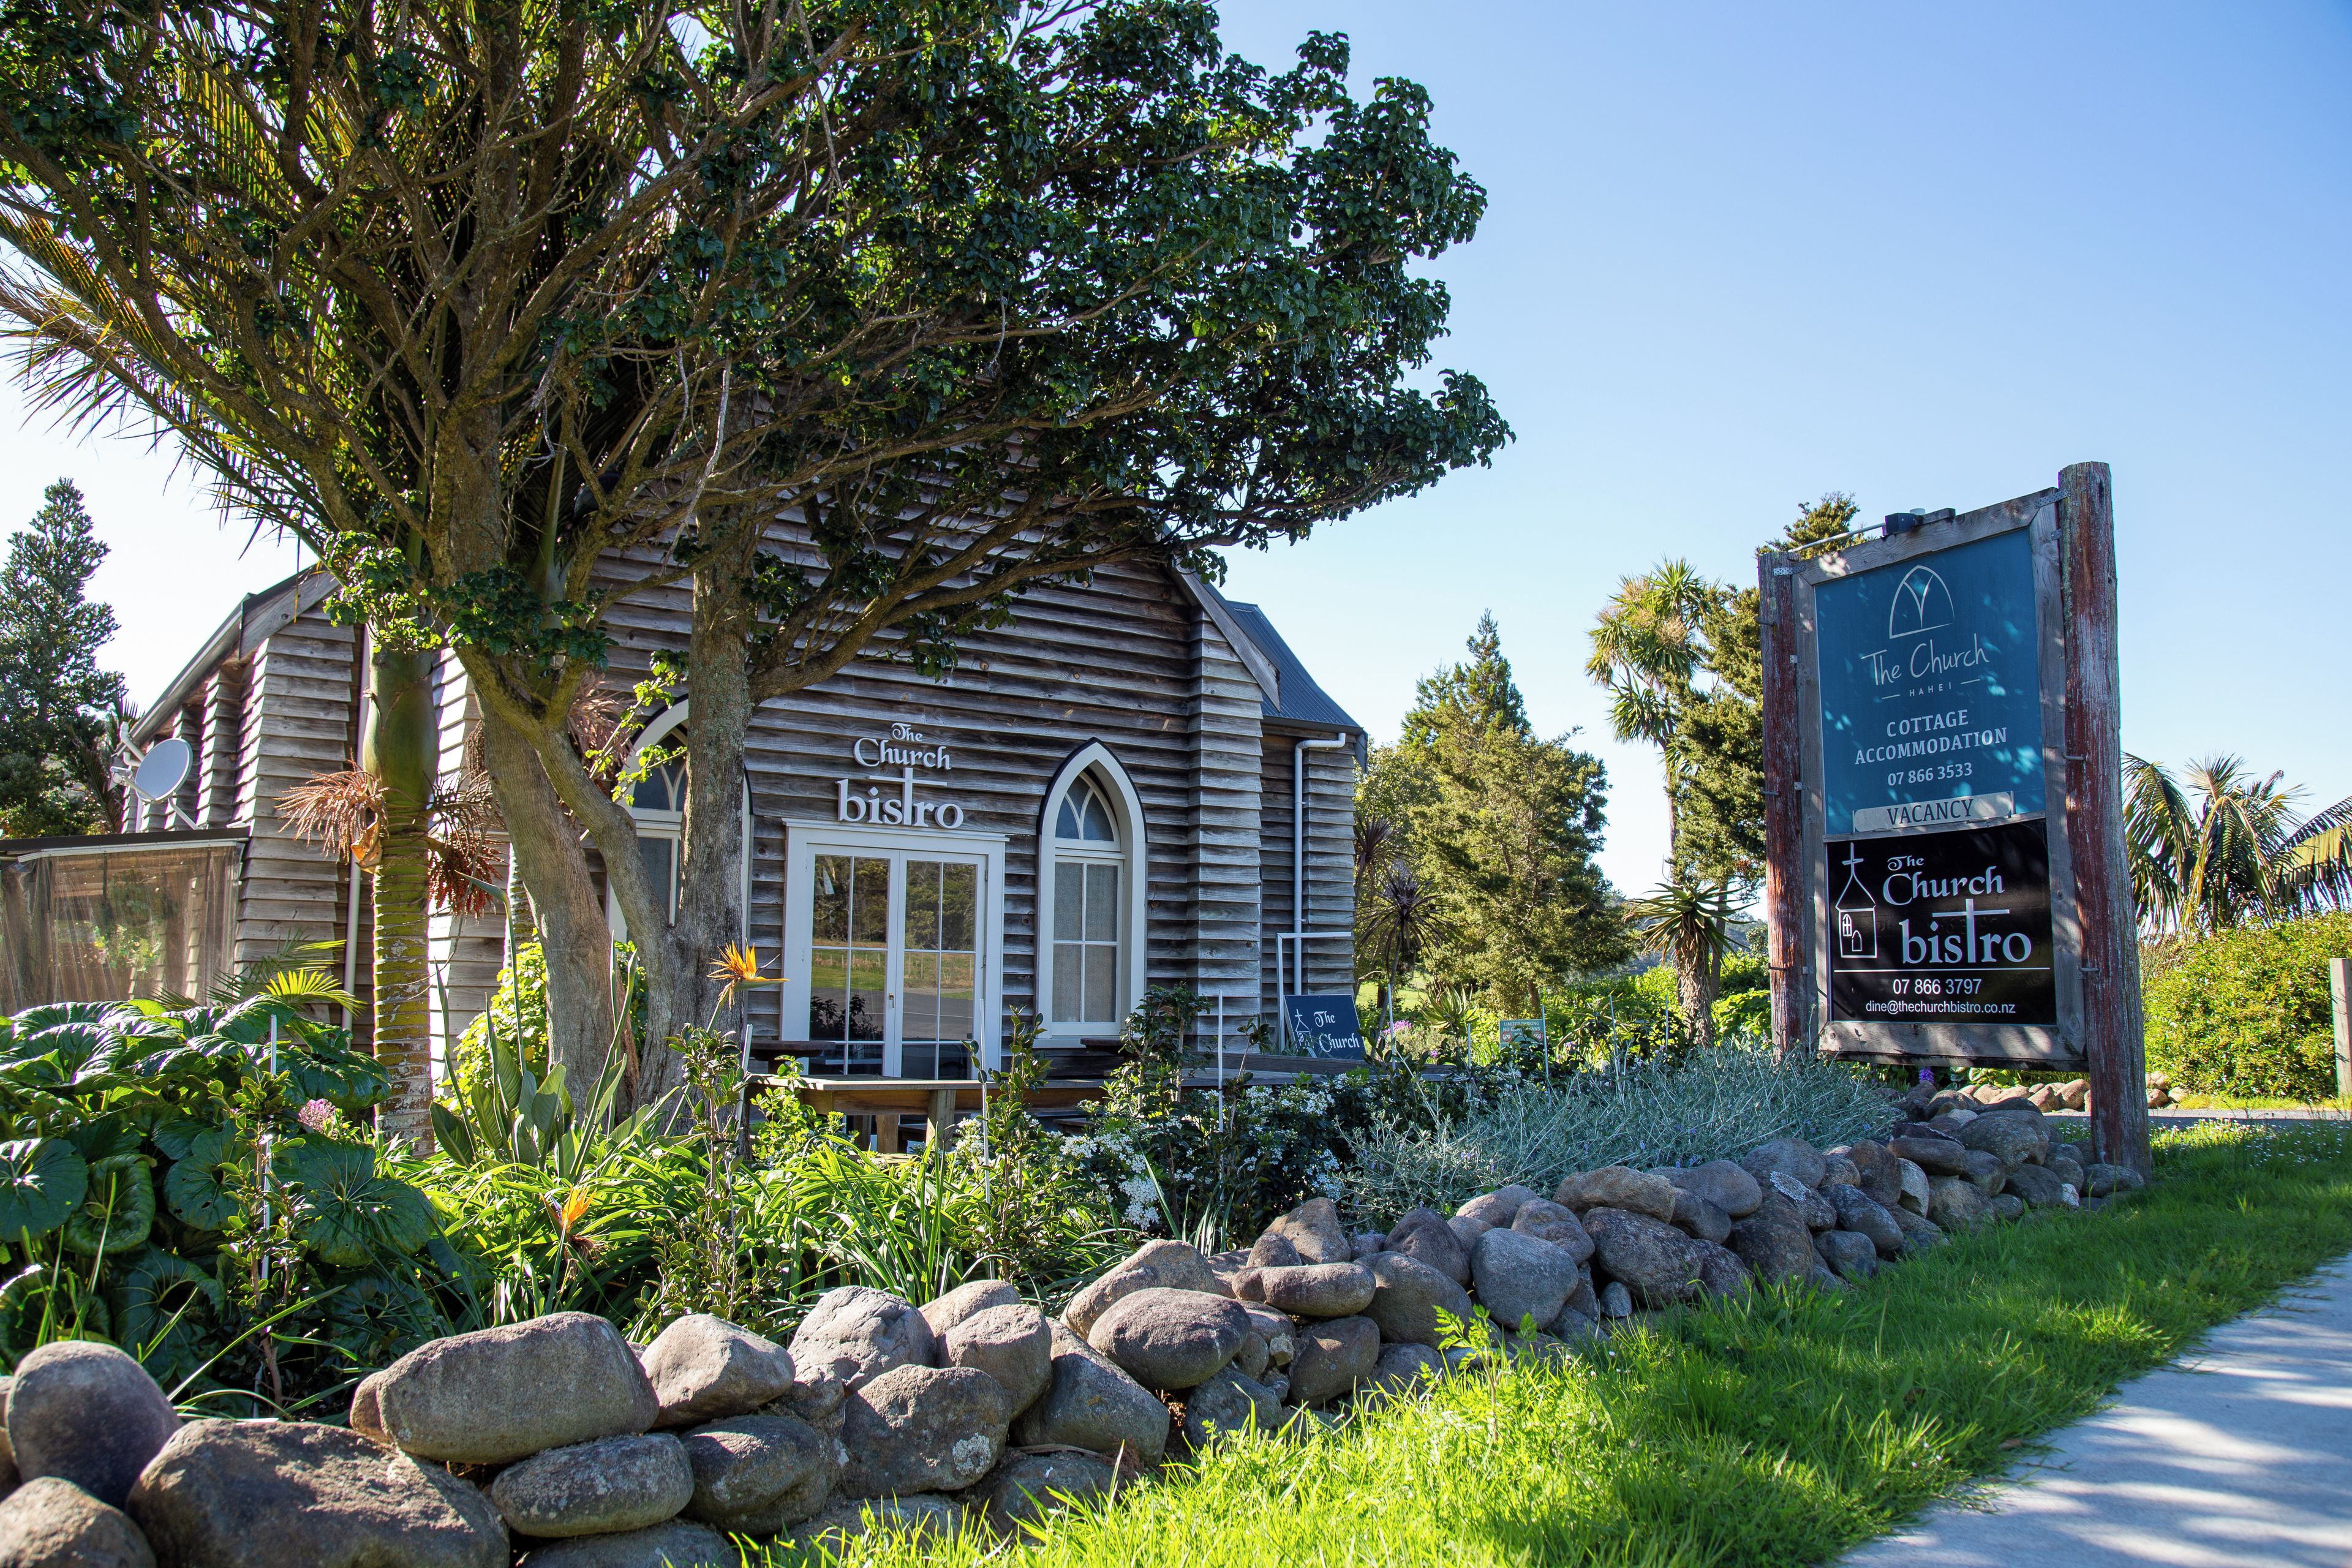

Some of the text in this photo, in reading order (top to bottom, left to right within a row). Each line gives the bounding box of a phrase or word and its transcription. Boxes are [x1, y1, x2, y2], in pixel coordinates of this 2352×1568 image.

[1861, 633, 1990, 685] The Church
[1909, 682, 1952, 697] HAHEI
[891, 722, 923, 742] The
[1887, 709, 1969, 737] COTTAGE
[853, 737, 952, 771] Church
[1855, 727, 2007, 765] ACCOMMODATION
[1887, 762, 1972, 786] 07 866 3533
[835, 767, 964, 829] bistro
[1887, 799, 1973, 825] VACANCY
[1887, 855, 1924, 871] The
[1882, 865, 2005, 906] Church
[1899, 898, 2032, 964] bistro
[1893, 979, 1982, 995] 07 866 3797
[1313, 1011, 1336, 1027] The
[1866, 1000, 2016, 1015] dine@thechurchbistro.co.nz
[1319, 1033, 1360, 1052] Church
